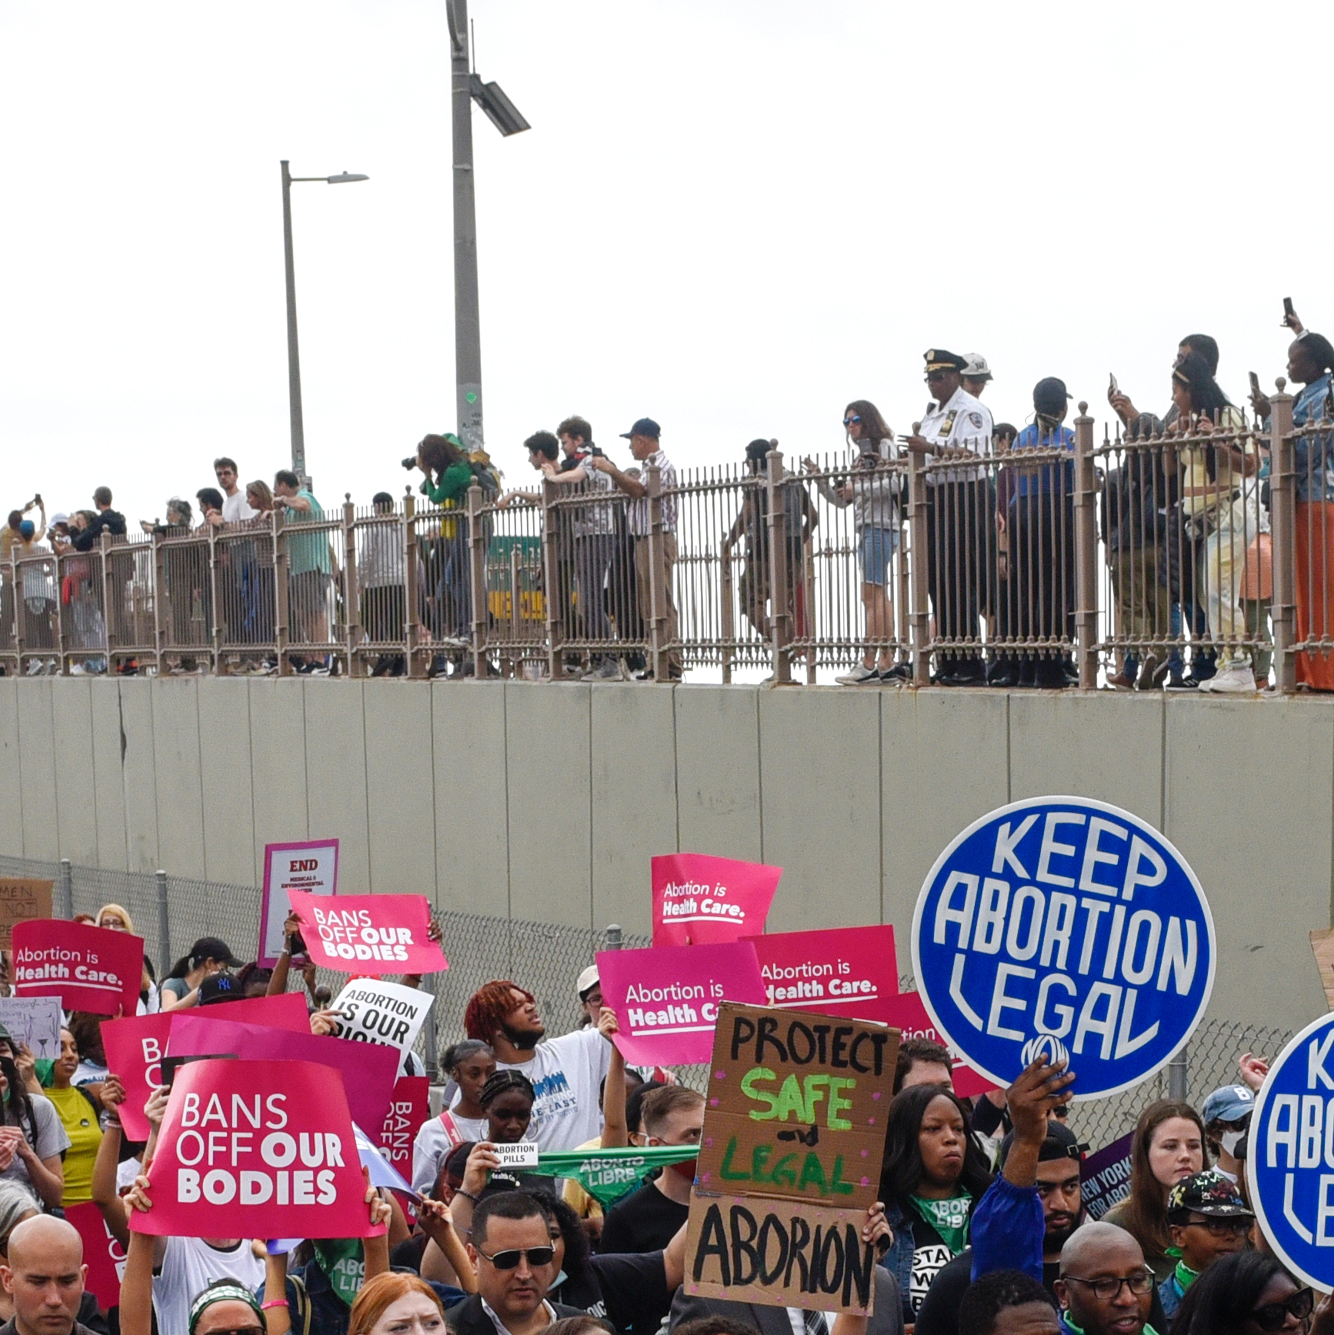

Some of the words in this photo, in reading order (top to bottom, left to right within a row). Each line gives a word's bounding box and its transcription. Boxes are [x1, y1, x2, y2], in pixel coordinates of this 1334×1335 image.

[289, 859, 318, 873] END
[991, 812, 1168, 901] KEEP
[281, 880, 324, 889] ENVIRONMENTAL
[290, 875, 312, 883] MEDICAL
[663, 880, 709, 897] Abortion
[714, 883, 726, 897] is
[313, 907, 372, 927] BANS
[663, 898, 697, 916] Health
[701, 899, 745, 918] Care.
[319, 925, 358, 943] OFF
[361, 927, 414, 945] OUR
[933, 870, 1197, 996] ABORTION
[16, 946, 81, 964] Abortion
[87, 949, 99, 964] is
[322, 940, 409, 961] BODIES
[15, 963, 69, 981] Health
[75, 965, 123, 986] Care.
[762, 961, 833, 981] Abortion
[838, 959, 850, 974] is
[626, 982, 706, 1004] Abortion
[710, 980, 724, 997] is
[764, 979, 824, 1000] Health
[828, 979, 877, 997] Care.
[345, 989, 419, 1020] ABORTION
[949, 953, 1160, 1060] LEGAL
[628, 1004, 698, 1027] Health
[362, 1008, 411, 1045] OUR
[731, 1017, 888, 1076] PROTECT
[741, 1066, 857, 1131] SAFE
[181, 1093, 288, 1129] BANS
[393, 1101, 412, 1162] BANS
[176, 1130, 253, 1167] OFF
[260, 1132, 346, 1168] OUR
[495, 1145, 535, 1154] ABORTION
[503, 1155, 525, 1163] PILLS
[720, 1136, 854, 1196] LEGAL
[1099, 1154, 1133, 1190] YORK
[178, 1168, 337, 1205] BODIES
[589, 1168, 636, 1188] LIBRE
[931, 1200, 971, 1217] ABOR
[1087, 1199, 1107, 1219] FOR
[937, 1214, 967, 1229] LIB
[693, 1203, 874, 1308] ABORION
[913, 1248, 956, 1266] STA
[334, 1258, 365, 1275] ABO
[340, 1275, 366, 1292] LIB
